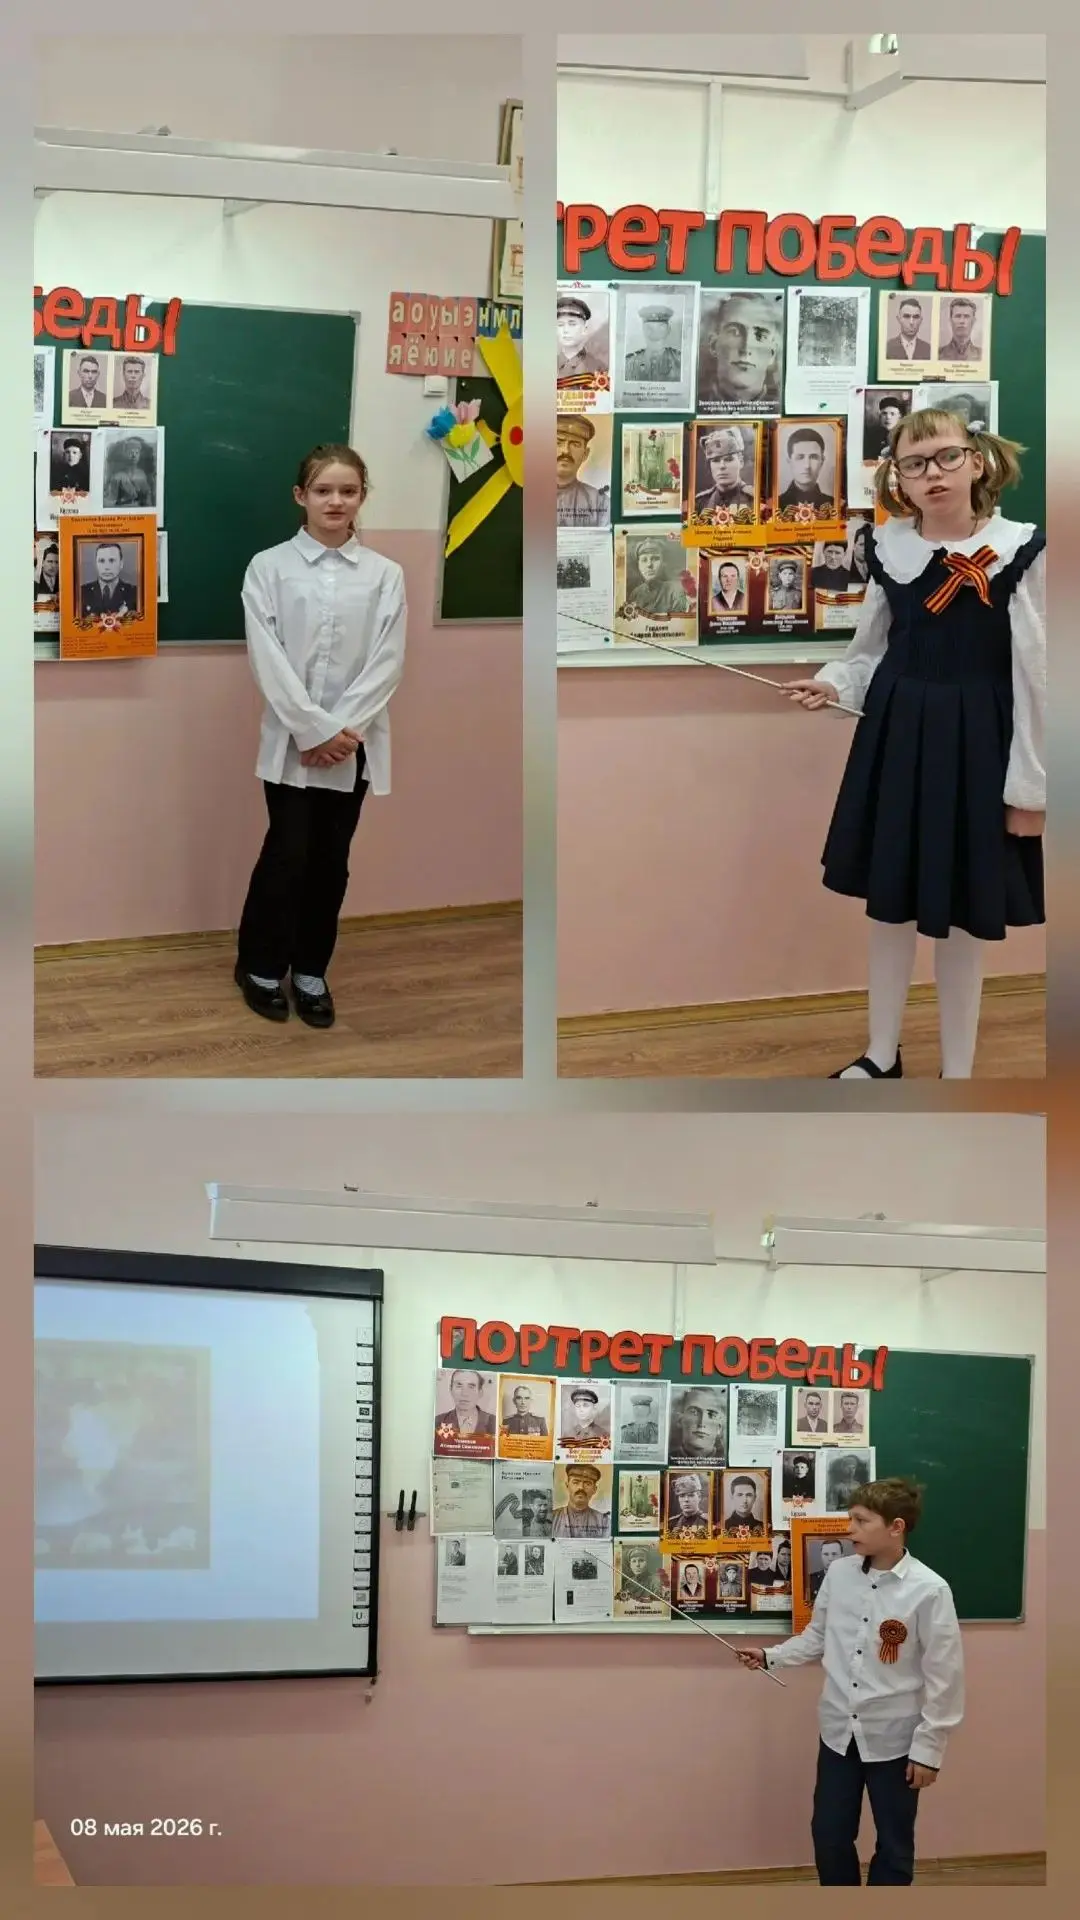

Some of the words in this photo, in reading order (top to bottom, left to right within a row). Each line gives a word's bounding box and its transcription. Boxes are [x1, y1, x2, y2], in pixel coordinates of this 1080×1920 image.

[557, 202, 705, 275] РЕТ
[715, 209, 1021, 297] ПОБЕДЫ
[440, 1316, 674, 1375] ПОРТРЕТ
[681, 1334, 889, 1391] ПОБЕДЫ
